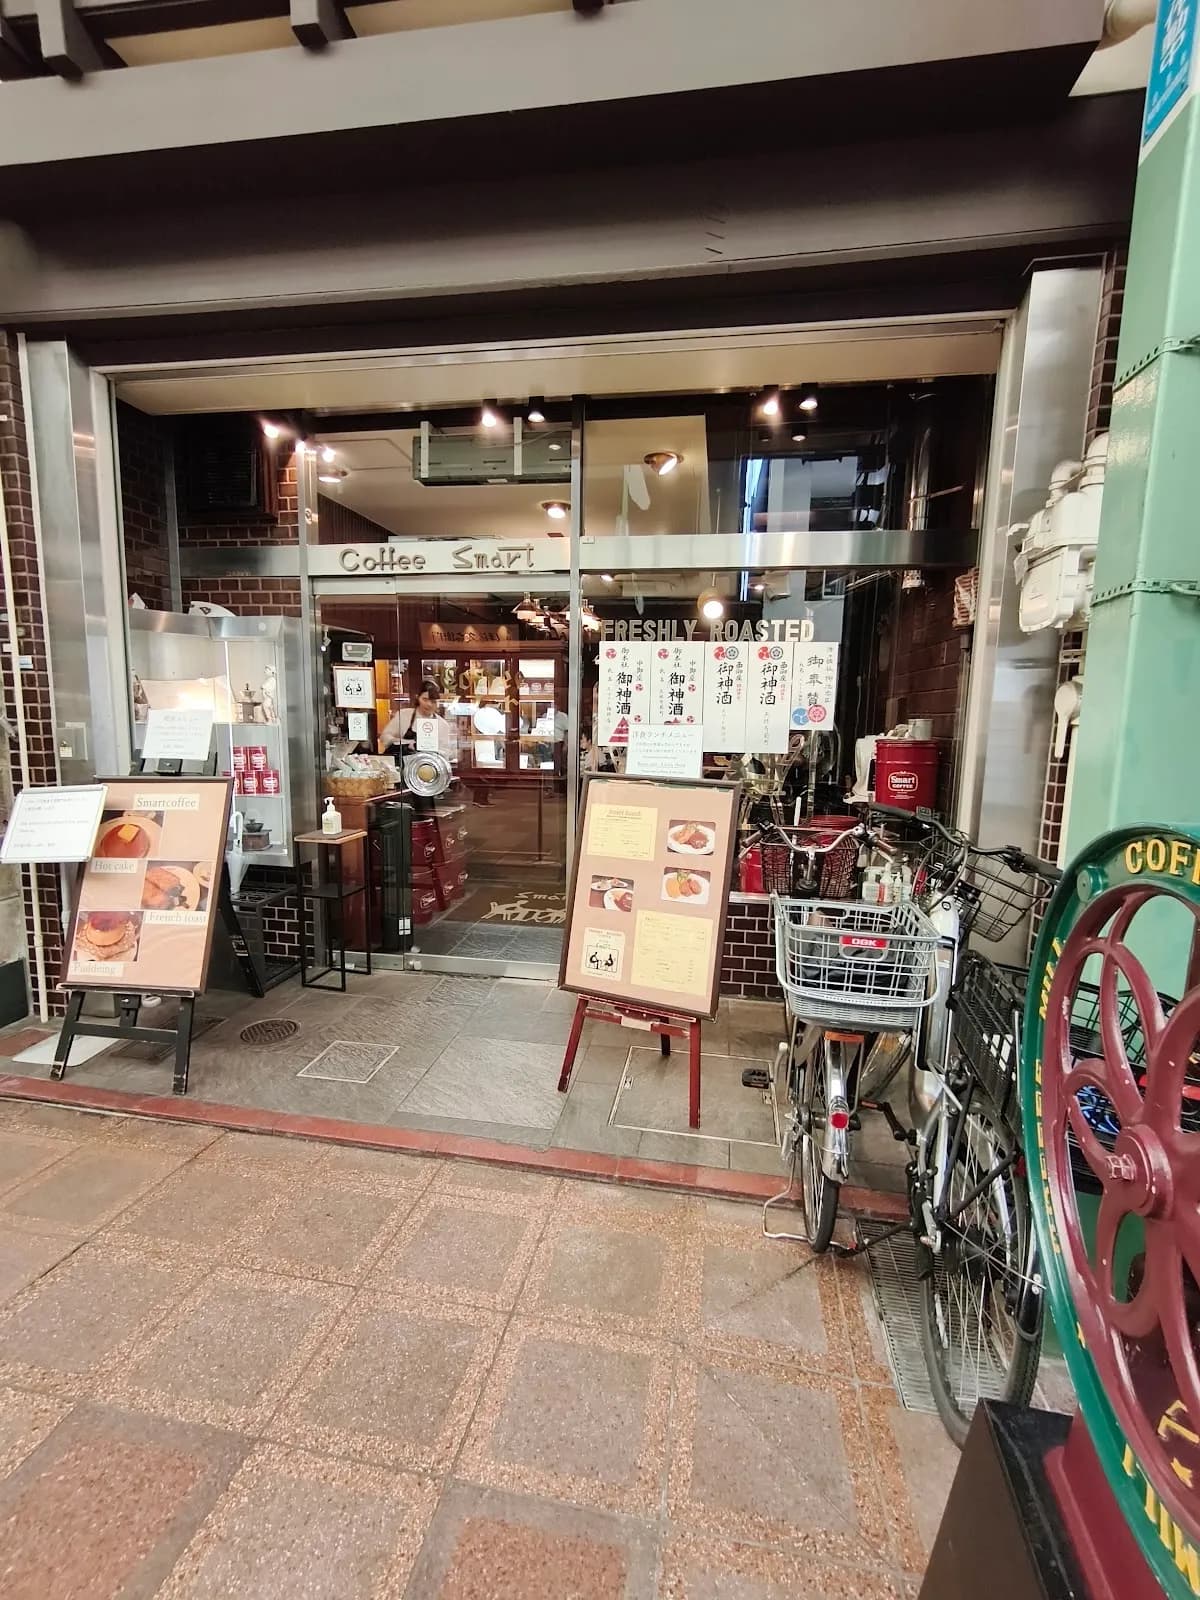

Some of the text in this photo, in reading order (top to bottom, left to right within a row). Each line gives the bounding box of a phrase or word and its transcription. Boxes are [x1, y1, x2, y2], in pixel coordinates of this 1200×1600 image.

[339, 543, 535, 572] Coffee Smart
[600, 619, 815, 641] FRESHLY ROASTED
[616, 672, 633, 715] 御神酒
[668, 672, 685, 715] 御神酒
[716, 662, 734, 705] 御神酒
[760, 662, 778, 705] 御神酒
[891, 775, 915, 784] Smart
[137, 797, 197, 809] Smartcoffee
[1125, 839, 1200, 884] COF
